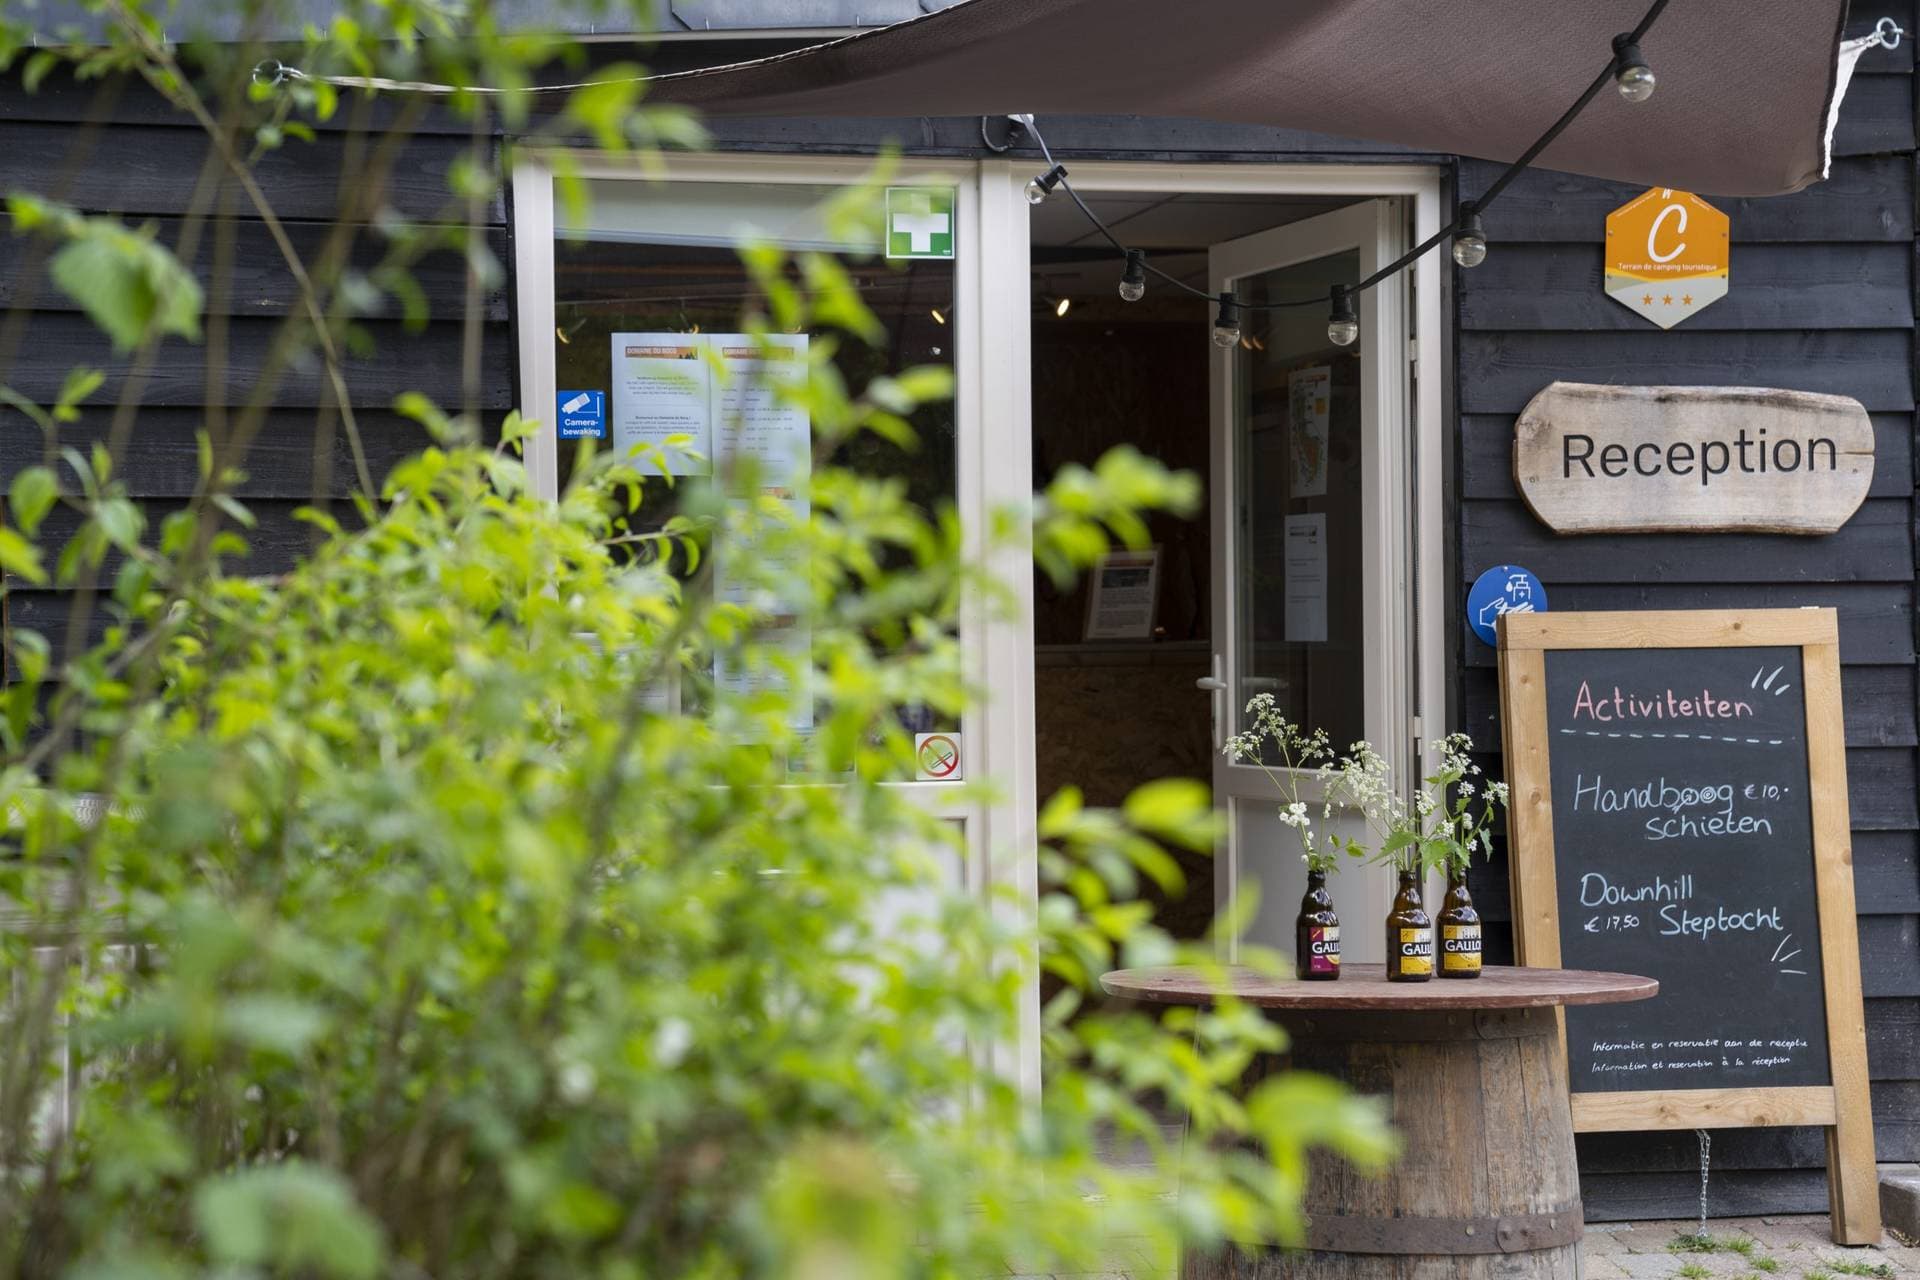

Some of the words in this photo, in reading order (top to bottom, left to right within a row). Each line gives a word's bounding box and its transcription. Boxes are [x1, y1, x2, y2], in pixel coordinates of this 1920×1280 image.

[1647, 203, 1688, 263] C
[1618, 262, 1642, 271] Terrain
[1643, 263, 1652, 271] de
[1653, 263, 1681, 272] camping
[1682, 263, 1718, 272] touristique
[564, 418, 599, 427] Camera-
[1563, 427, 1837, 486] Reception
[1573, 680, 1754, 722] Activiteiten
[1574, 774, 1734, 815] Handboog
[1580, 872, 1693, 907] Downhill
[1659, 903, 1785, 941] Steptocht
[1592, 1040, 1645, 1052] Informatie
[1651, 1041, 1664, 1050] en
[1668, 1039, 1719, 1048] reservatie
[1724, 1040, 1743, 1048] aan
[1749, 1039, 1763, 1047] de
[1591, 1061, 1648, 1073] Information
[1651, 1060, 1664, 1070] et
[1735, 1058, 1745, 1066] la
